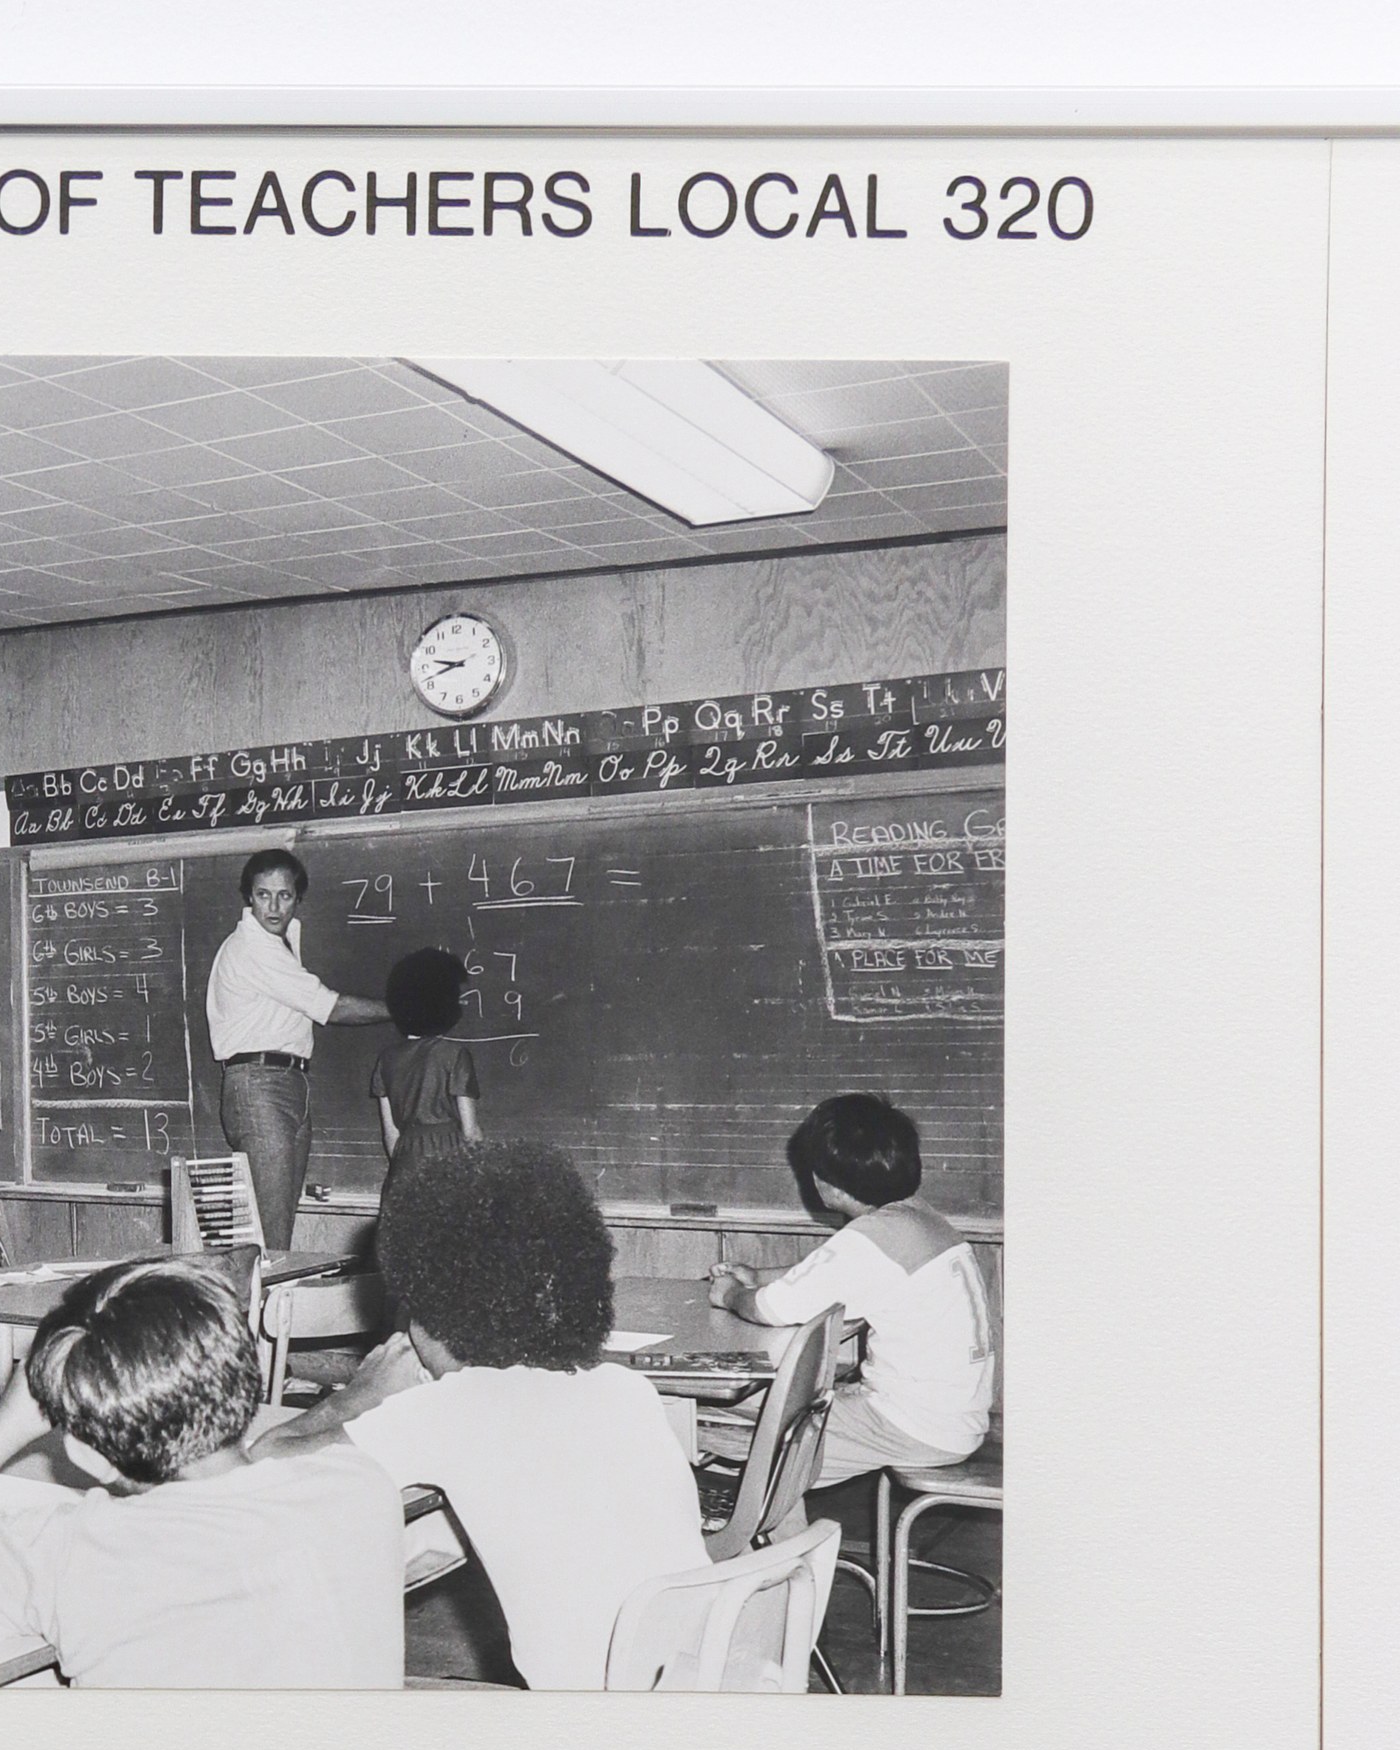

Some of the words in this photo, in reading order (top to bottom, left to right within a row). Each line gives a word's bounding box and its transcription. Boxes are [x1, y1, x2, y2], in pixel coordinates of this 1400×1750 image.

[134, 170, 593, 238] TEACHERS
[630, 171, 908, 239] LOCAL
[943, 175, 1094, 241] 320
[437, 632, 444, 640] 11
[452, 625, 461, 634] 12
[472, 627, 475, 635] 1
[426, 646, 435, 655] 10
[483, 639, 489, 648] 2
[422, 664, 429, 673] 9
[488, 655, 495, 665] 3
[427, 682, 434, 690] 8
[483, 674, 491, 682] 4
[441, 692, 447, 701] 7
[456, 695, 463, 704] 6
[472, 688, 480, 697] 5
[44, 773, 72, 798] Bb
[80, 770, 108, 793] Cc
[114, 764, 144, 790] Dd
[190, 755, 219, 781] Ff
[230, 753, 266, 782] Gg
[270, 746, 306, 772] Hh
[356, 739, 381, 772] Jj
[406, 733, 440, 760] Kk
[492, 723, 540, 752] Mm
[542, 720, 581, 747] Nn
[642, 706, 679, 743] Pp
[695, 700, 745, 740] Qq
[752, 695, 790, 725] Rr
[811, 690, 844, 720] Ss
[862, 683, 896, 715] Tt
[14, 814, 41, 835] Aa
[45, 808, 74, 832] Bb
[84, 804, 108, 828] Cc
[113, 802, 146, 826] Dd
[404, 772, 448, 800] Kk
[447, 769, 489, 798] Ll
[494, 765, 548, 792] Mm
[600, 754, 634, 782] Oo
[643, 750, 687, 788] Pp
[752, 740, 799, 770] Rr
[812, 736, 854, 765] Ss
[867, 729, 912, 760] Tt
[924, 725, 982, 754] Uu
[831, 820, 947, 847] READING
[830, 860, 843, 877] A
[852, 856, 903, 876] TIME
[914, 852, 963, 872] FOR
[32, 876, 129, 893] TOWNSEND
[342, 874, 393, 911] 79
[419, 871, 442, 904] +
[65, 901, 109, 919] BOYS
[137, 898, 159, 916] 3
[32, 940, 56, 963] 6th
[64, 940, 116, 965] GIRLS
[139, 938, 163, 959] 3
[852, 951, 905, 967] PLACE
[916, 950, 952, 967] FOR
[964, 950, 999, 964] ME
[464, 949, 516, 981] 67
[67, 986, 108, 1004] BOYS
[136, 973, 148, 1003] 4
[65, 1025, 115, 1047] GIRLS
[70, 1063, 121, 1088] BOYS
[142, 1052, 154, 1081] 2
[36, 1118, 104, 1148] TOTAL
[144, 1109, 169, 1155] 13
